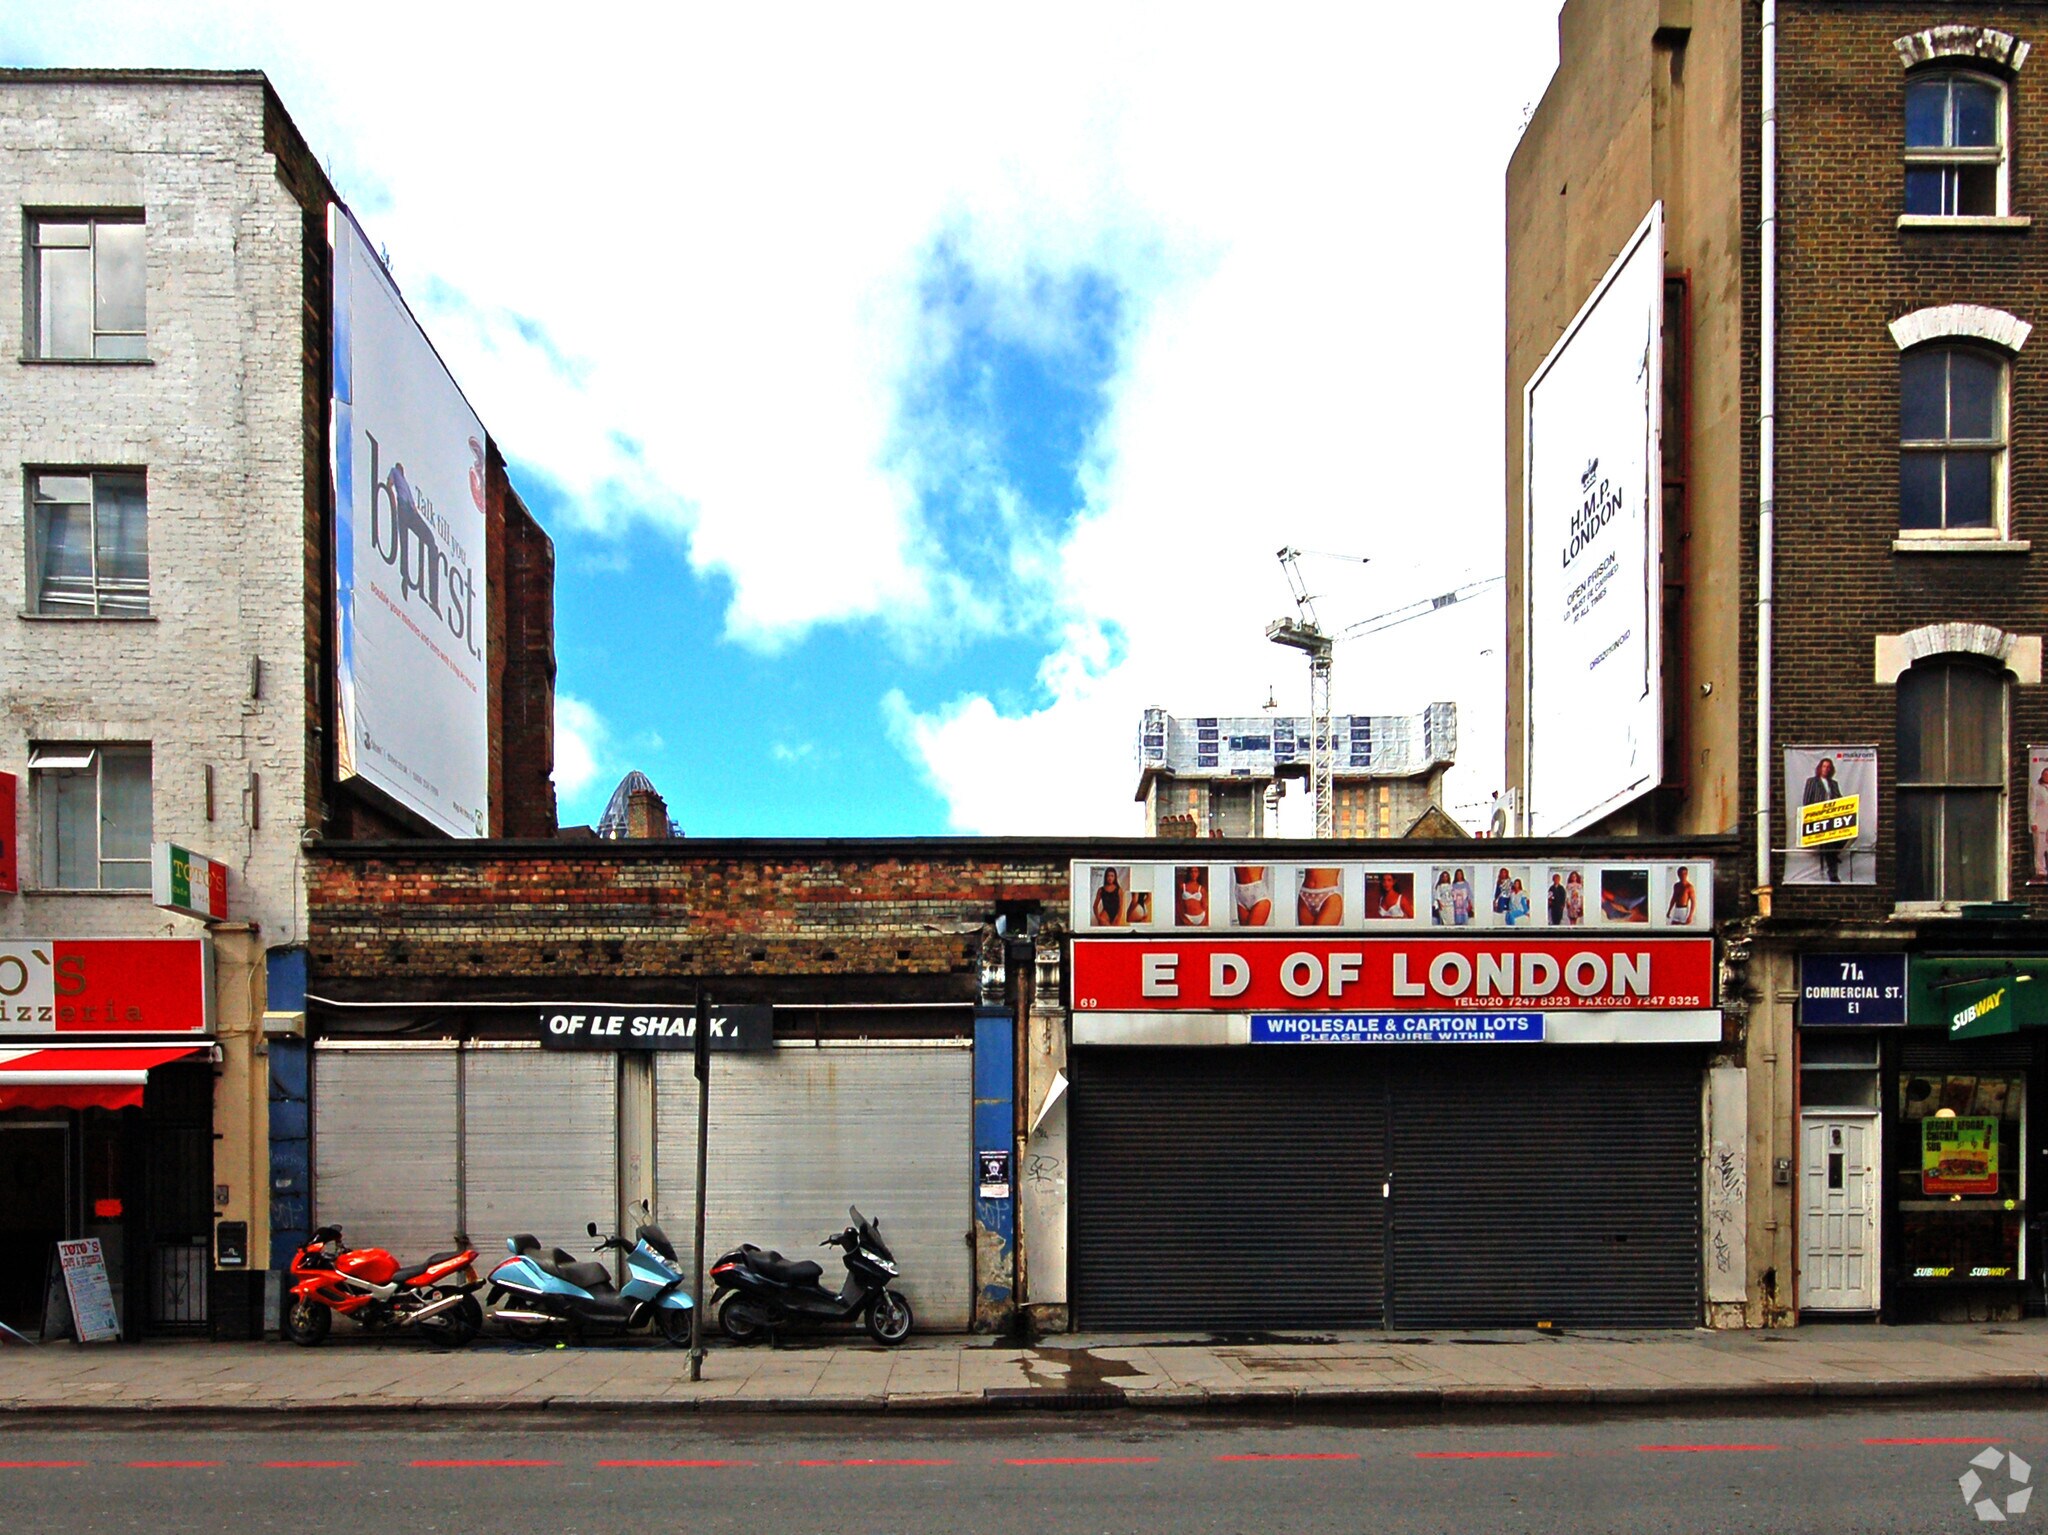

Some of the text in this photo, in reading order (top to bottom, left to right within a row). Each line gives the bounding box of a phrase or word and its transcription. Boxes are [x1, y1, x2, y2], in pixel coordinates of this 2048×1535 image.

[1571, 478, 1610, 537] H.M.P.
[415, 486, 467, 567] Talk till you
[1563, 486, 1622, 568] LONDON
[1567, 550, 1616, 606] OPEN PRISON
[1806, 820, 1829, 834] LET
[1833, 815, 1853, 829] BY
[1142, 952, 1651, 997] E D OF LONDON
[1508, 997, 1536, 1006] 7247
[1540, 997, 1571, 1006] 8323
[1636, 996, 1665, 1006] 7247
[1668, 996, 1700, 1006] 8325
[1805, 987, 1903, 999] COMMERCIAL ST.
[1080, 999, 1098, 1008] 69
[1848, 1002, 1860, 1014] E1
[1951, 988, 2006, 1032] SUBWAY
[549, 1015, 586, 1035] OF
[590, 1016, 625, 1036] LE
[1267, 1017, 1529, 1033] WHOLESALE & CARTON LOTS
[1300, 1032, 1496, 1042] PLEASE INQUIRE WITHIN
[1926, 1141, 1941, 1152] SUB
[1913, 1267, 2010, 1277] SUBWAY SUBWAY
